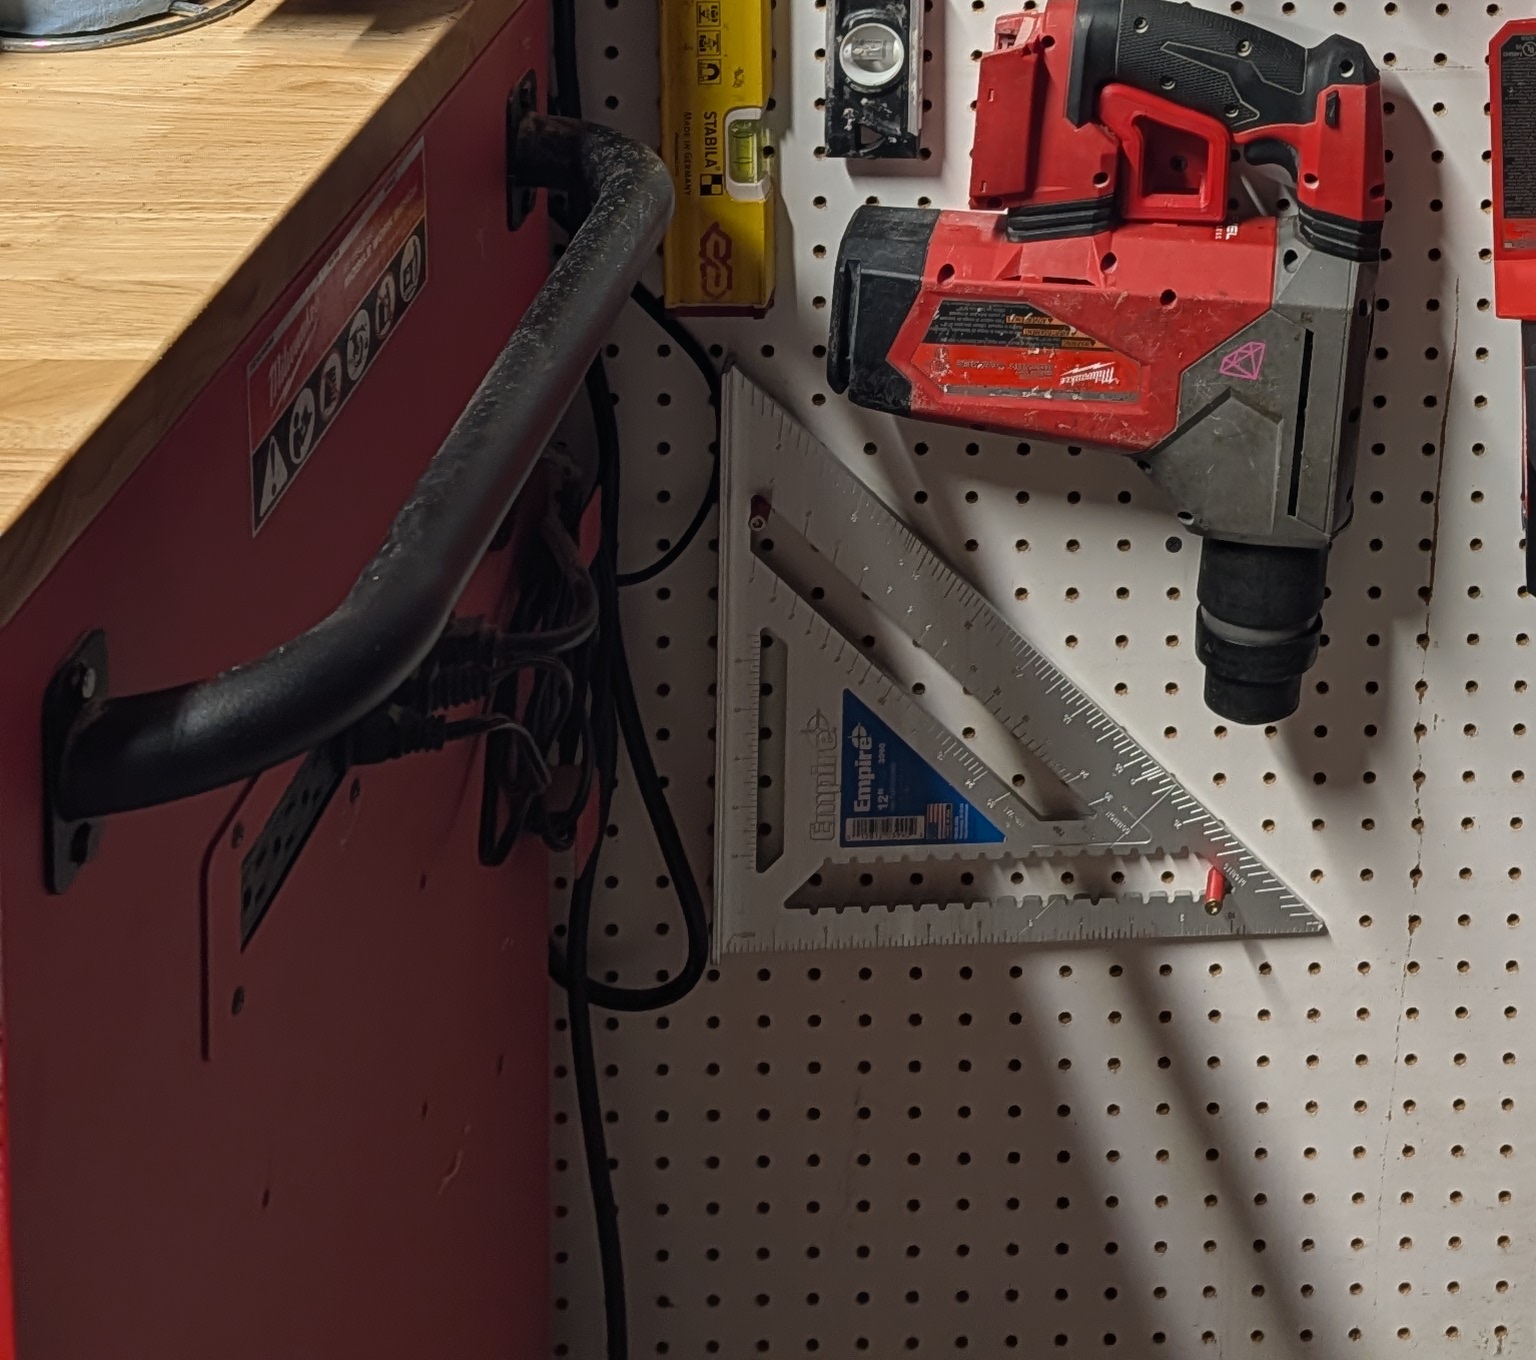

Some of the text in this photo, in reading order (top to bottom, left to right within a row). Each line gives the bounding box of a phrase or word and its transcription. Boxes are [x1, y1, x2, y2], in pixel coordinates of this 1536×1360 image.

[683, 112, 692, 137] MADE
[704, 111, 718, 168] STABILA
[683, 152, 692, 197] GERMANY
[1060, 365, 1121, 386] Milwaukee
[809, 727, 836, 841] Empire
[852, 736, 875, 813] Empire
